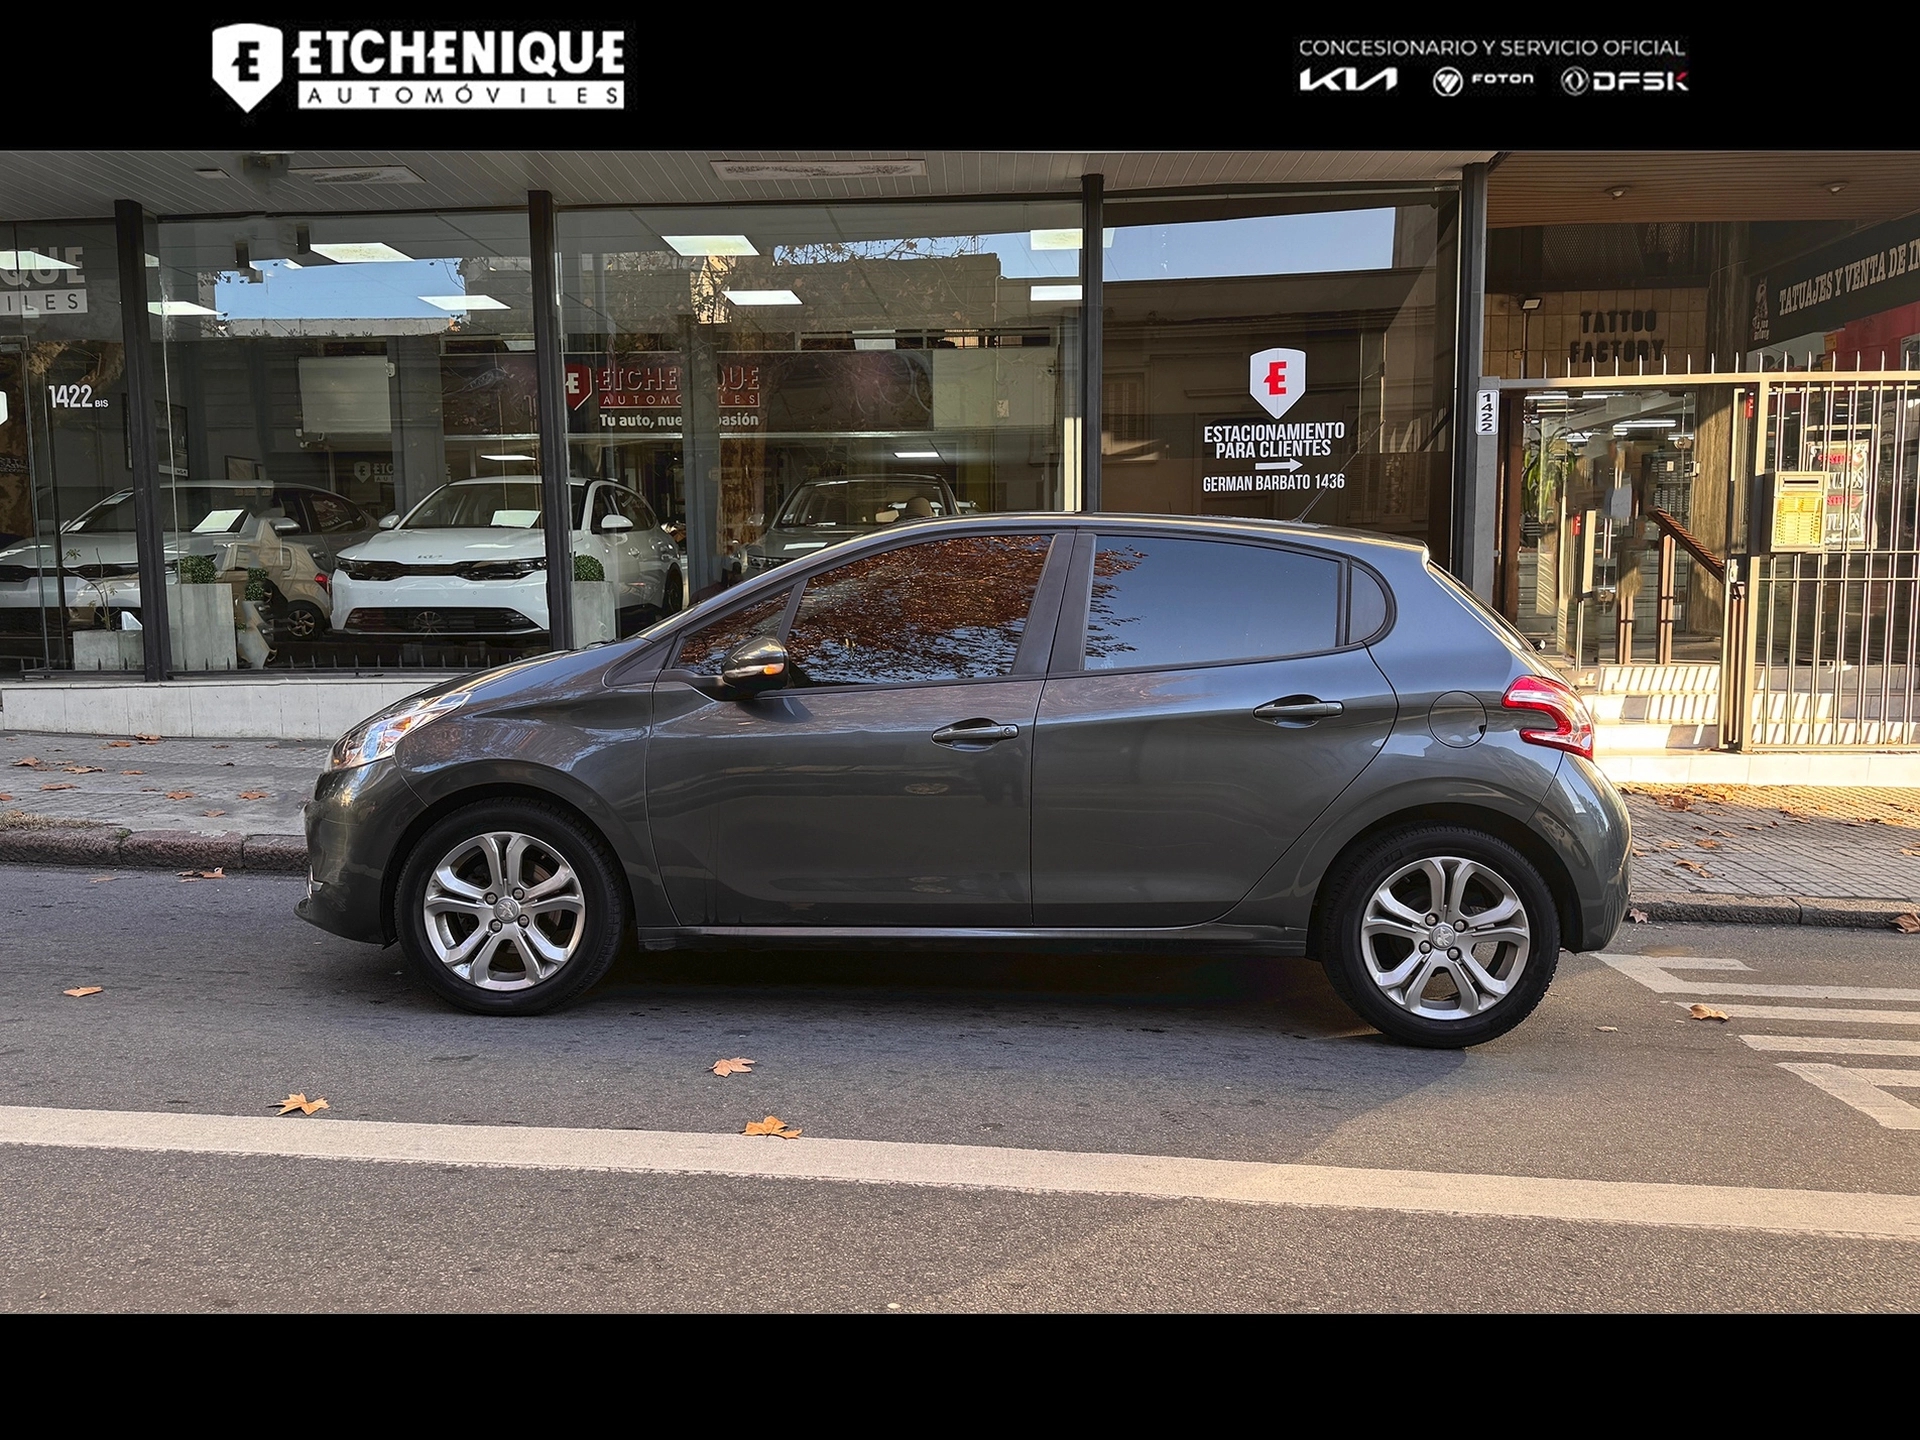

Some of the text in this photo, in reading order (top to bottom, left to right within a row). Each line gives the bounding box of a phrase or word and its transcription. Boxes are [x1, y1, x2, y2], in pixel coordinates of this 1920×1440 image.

[1779, 271, 1833, 316] TATUAJES
[1835, 267, 1844, 297] Y
[1845, 251, 1887, 293] VENTA
[1888, 243, 1906, 279] DE
[1580, 309, 1657, 333] TATTOO
[1570, 339, 1665, 363] FACTORY
[1263, 361, 1287, 395] E
[49, 384, 109, 408] 1422 BIS
[600, 414, 616, 427] Tu
[619, 415, 654, 429] auto,
[658, 417, 683, 427] nue
[1481, 393, 1493, 432] 1422
[1204, 422, 1345, 443] ESTACIONAMIENTO
[1216, 439, 1331, 459] PARA CLIENTES
[1203, 473, 1345, 492] GERMAN BARBATO 1436
